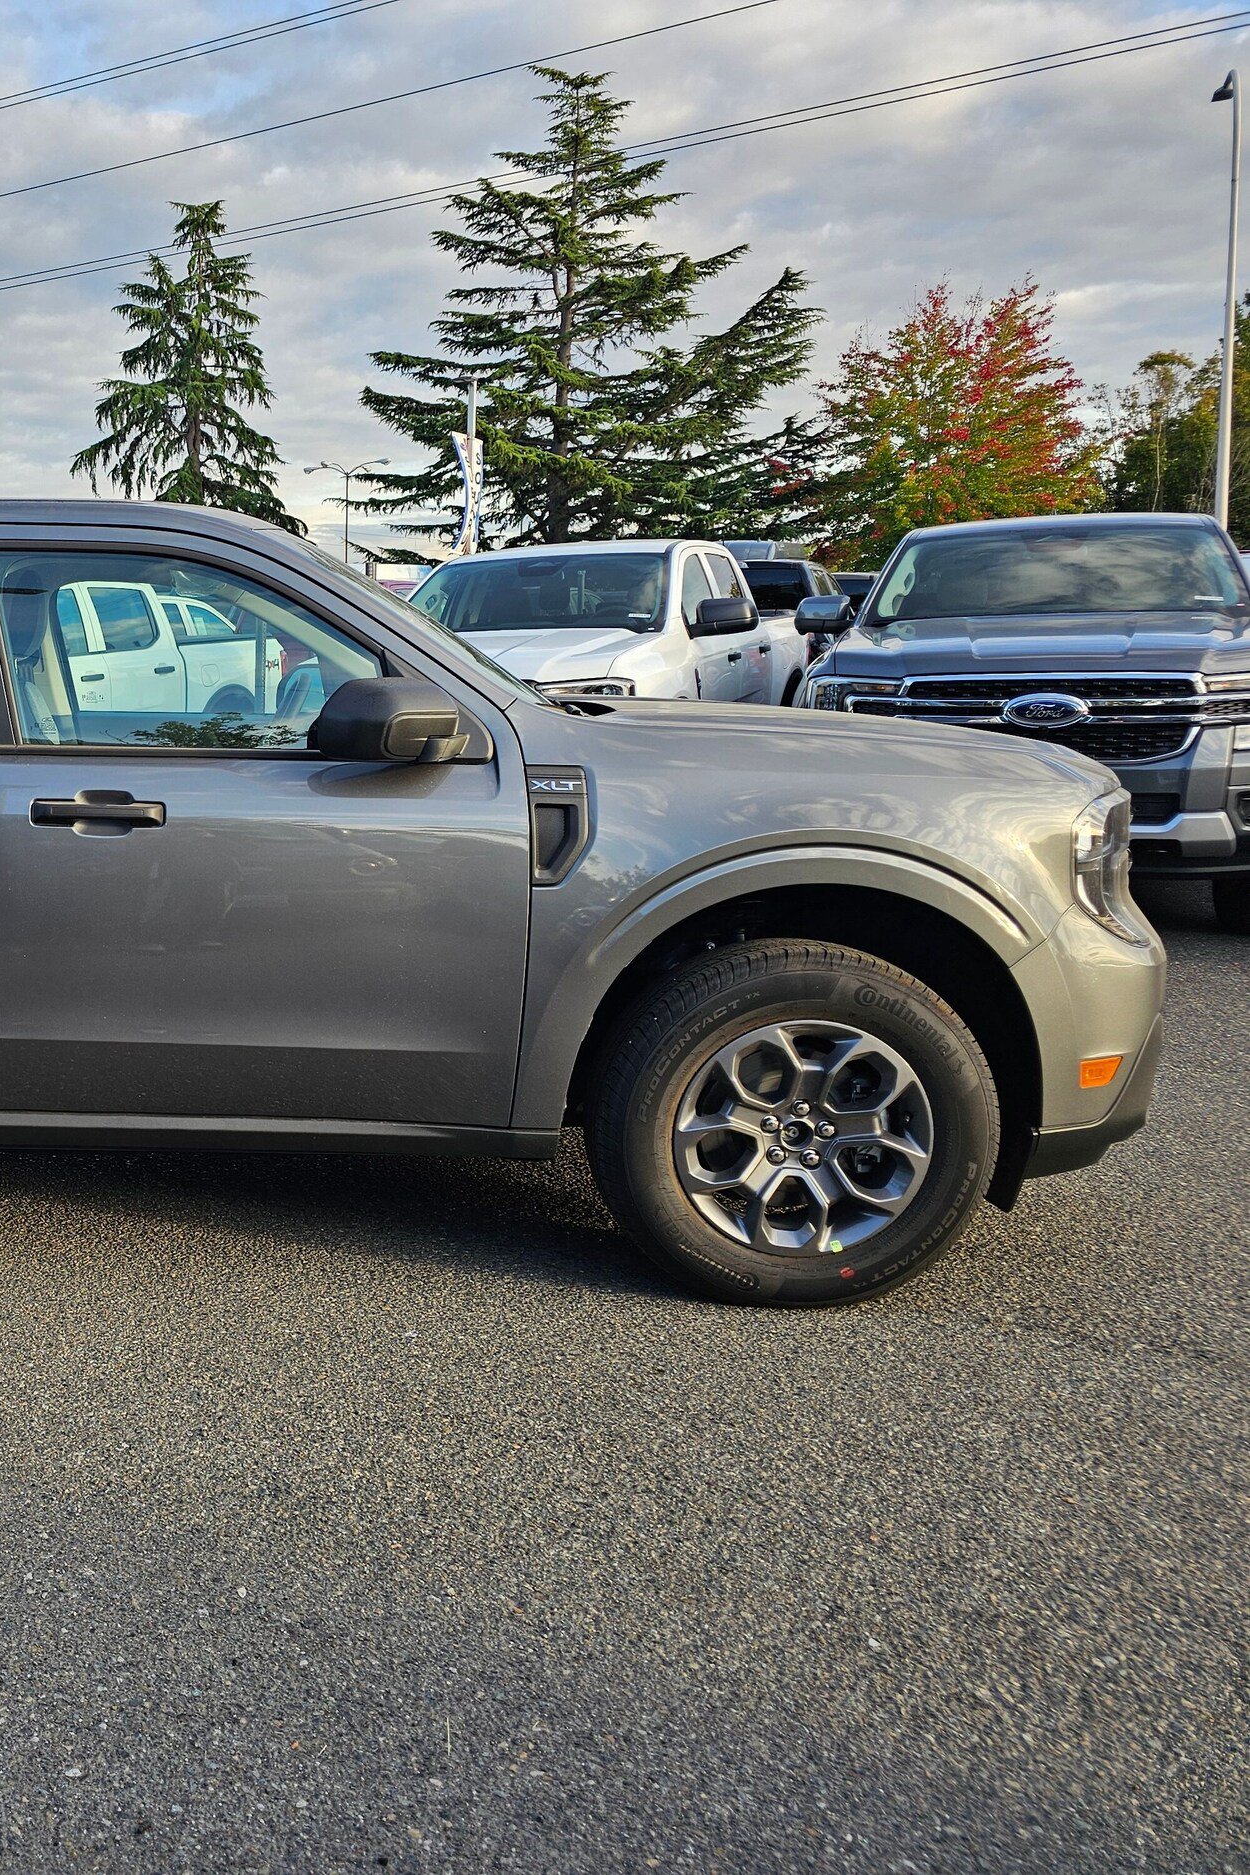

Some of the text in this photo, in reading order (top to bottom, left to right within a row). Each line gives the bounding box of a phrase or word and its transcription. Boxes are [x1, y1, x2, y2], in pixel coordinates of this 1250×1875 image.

[1025, 703, 1065, 718] Ford
[531, 780, 581, 791] XLT
[853, 984, 960, 1061] Continental
[636, 999, 741, 1122] PROCONTACT
